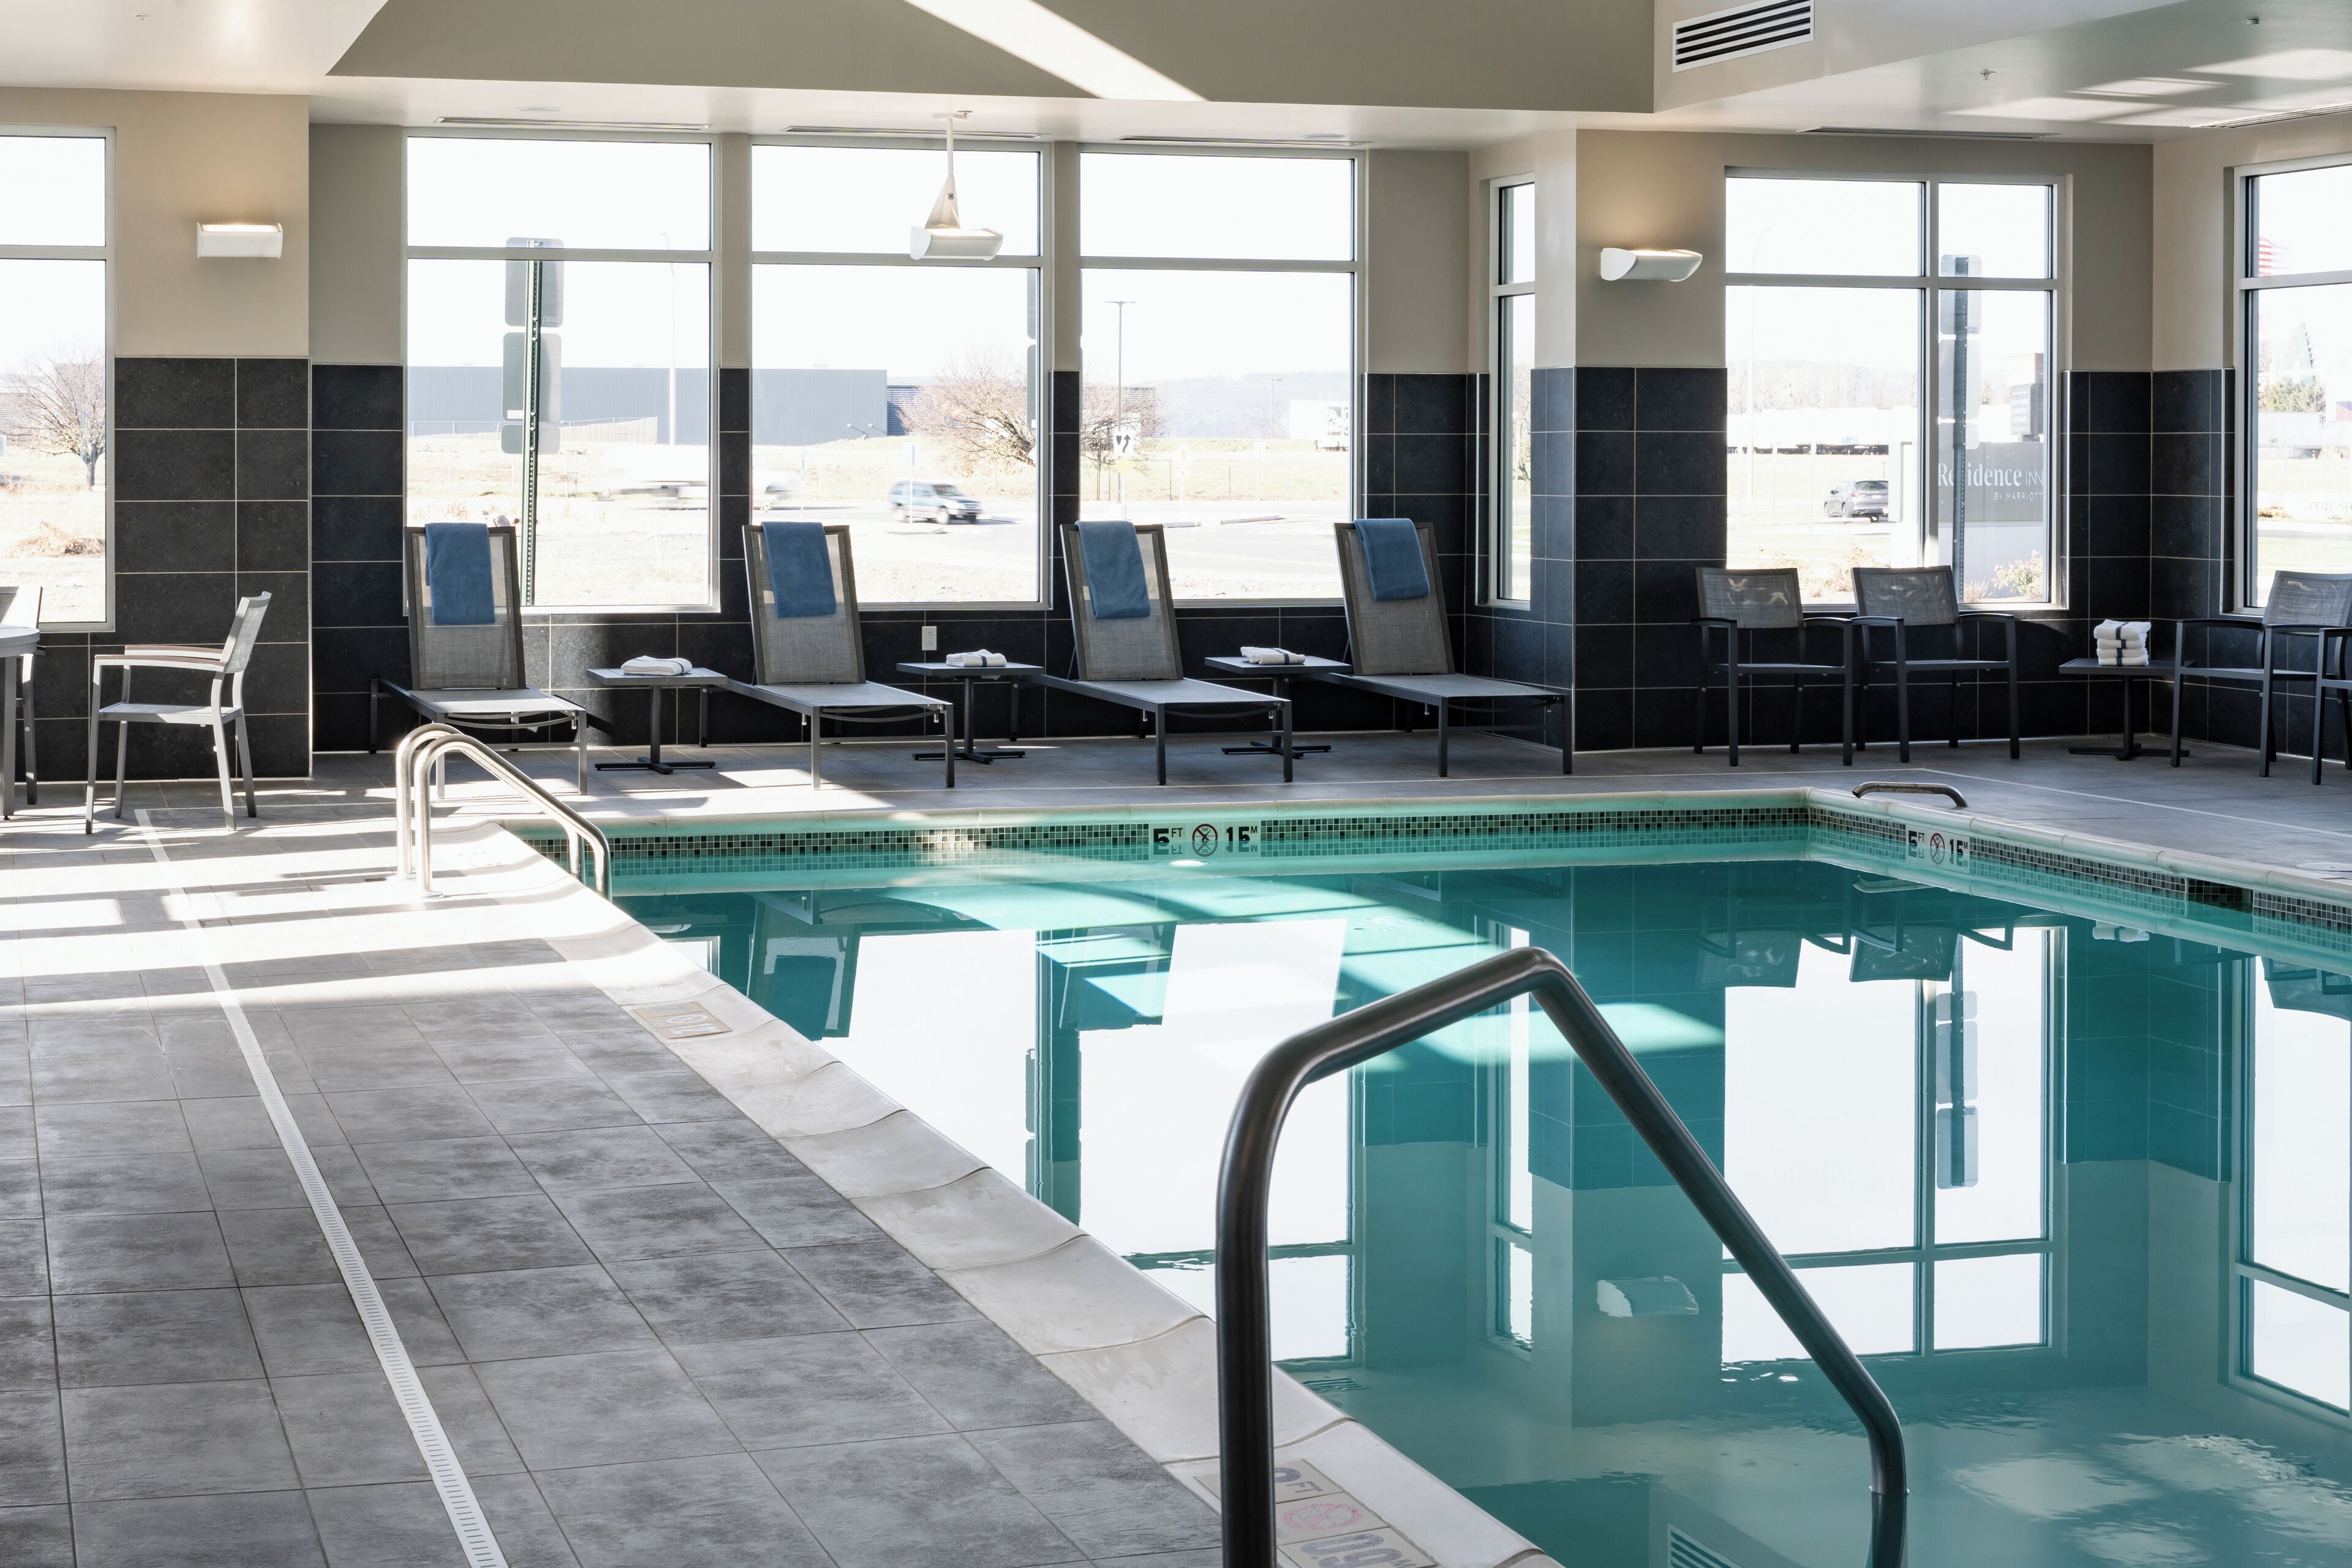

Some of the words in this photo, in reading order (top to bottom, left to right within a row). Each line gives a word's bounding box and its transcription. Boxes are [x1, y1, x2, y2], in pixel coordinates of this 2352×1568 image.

[1938, 462, 2022, 486] Reidence
[2026, 470, 2043, 486] INN
[1153, 828, 1170, 843] 5
[1171, 827, 1183, 837] FT
[1918, 832, 1925, 843] FT
